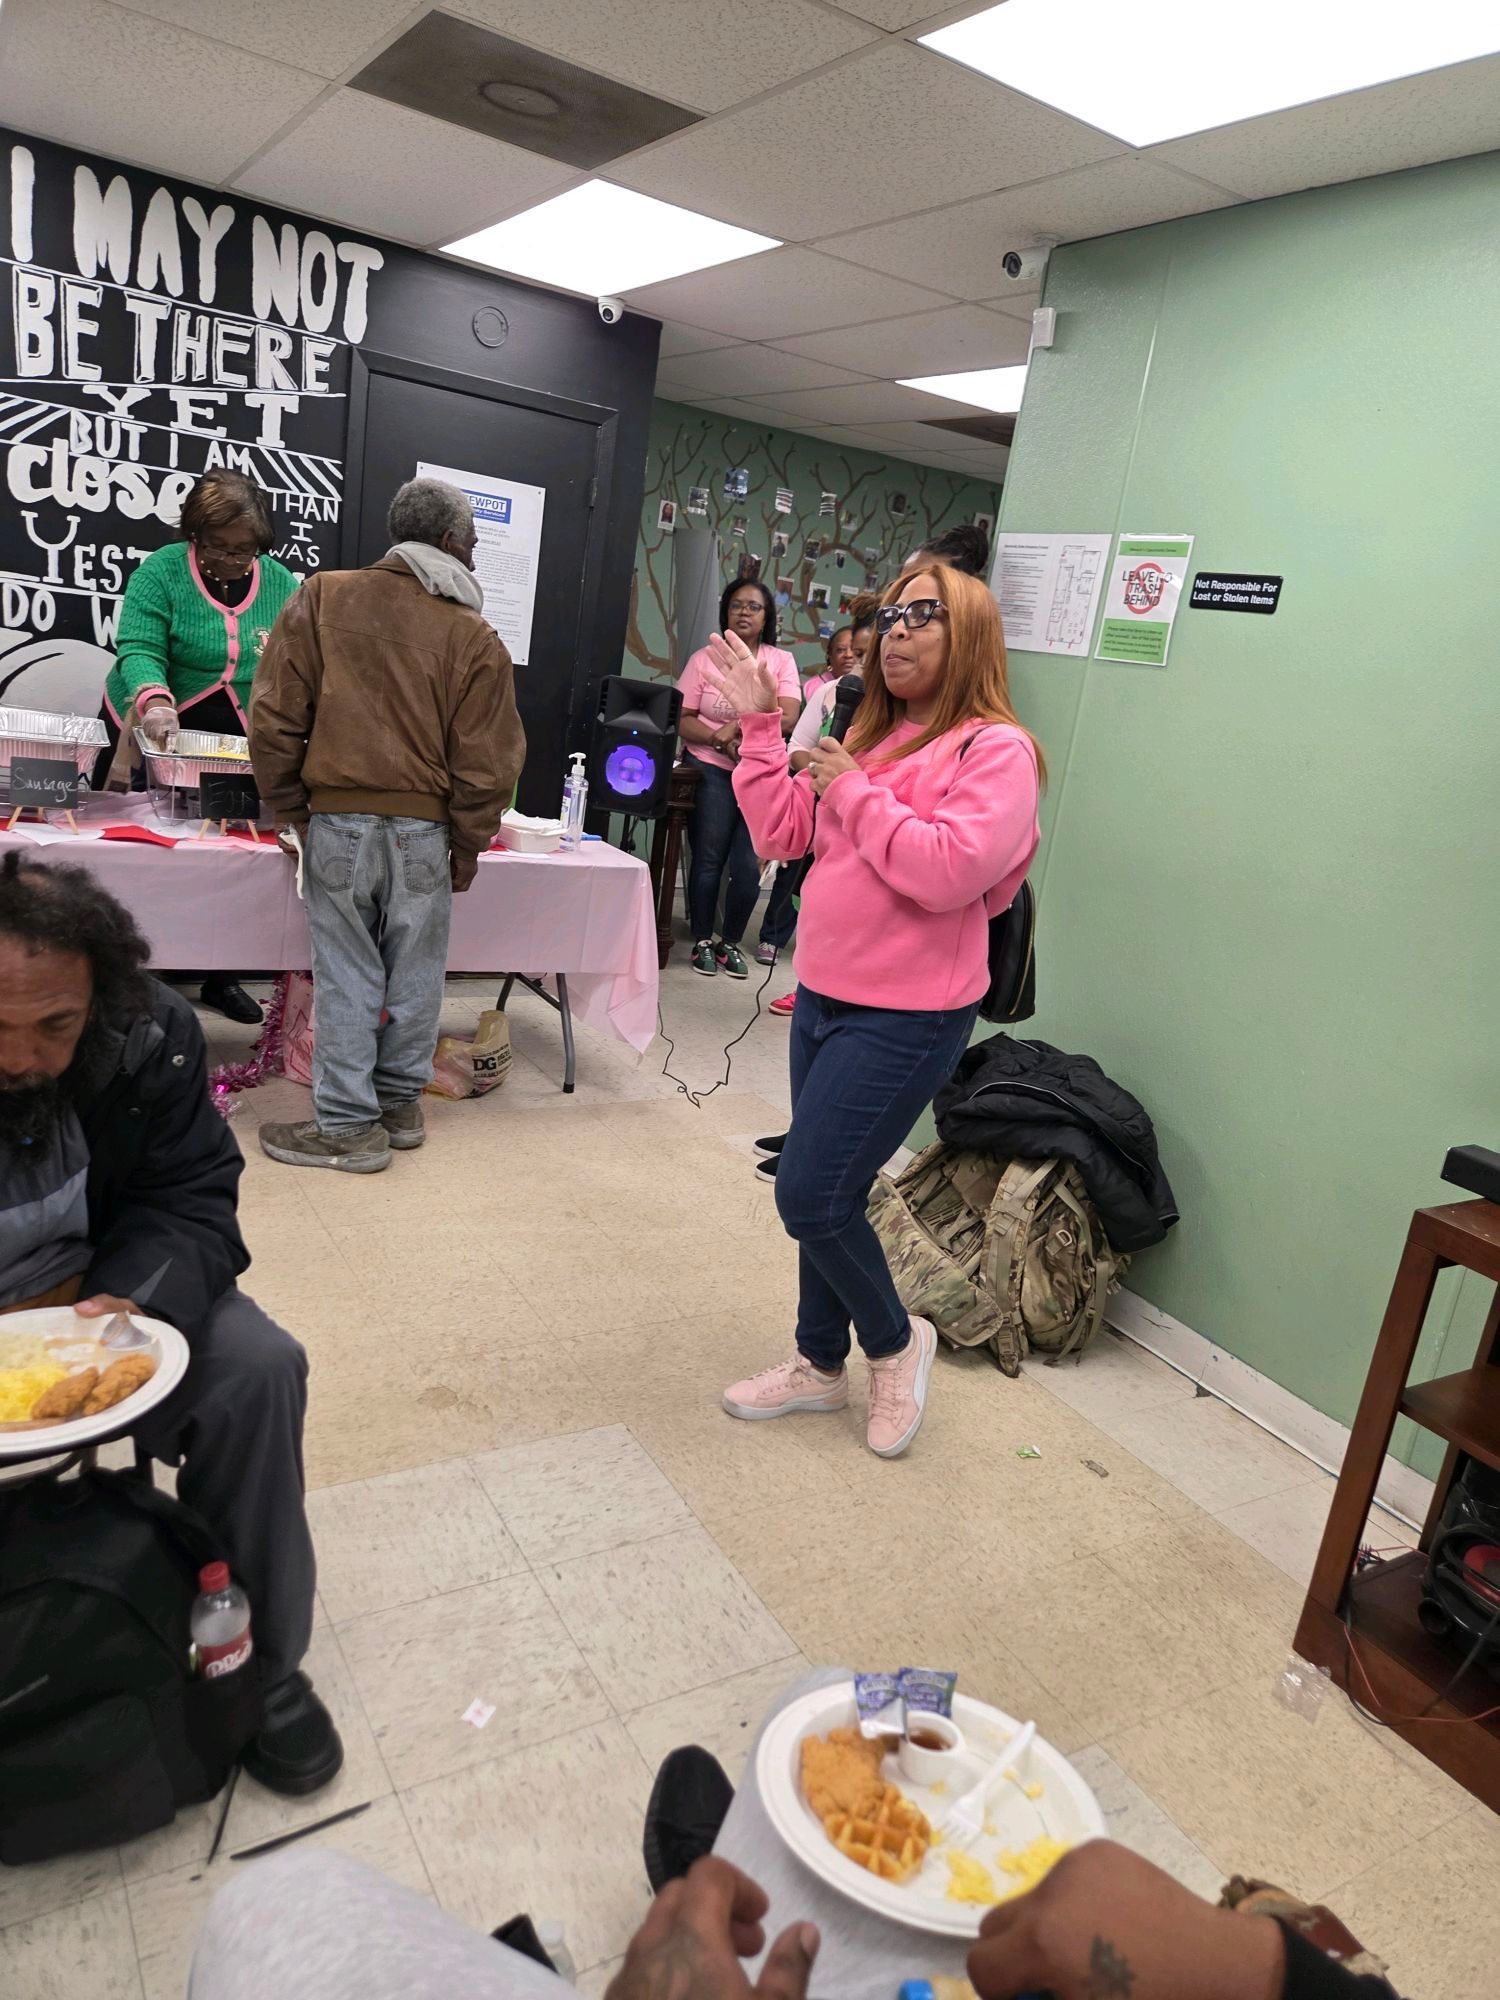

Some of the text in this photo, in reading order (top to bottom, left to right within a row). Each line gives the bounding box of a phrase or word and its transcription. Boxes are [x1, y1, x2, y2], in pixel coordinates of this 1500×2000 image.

[11, 145, 384, 344] I MAY NOT
[12, 265, 337, 392] BE THERE
[82, 385, 300, 448] YET
[69, 410, 250, 476] BUT I AM
[268, 490, 340, 524] THAN
[469, 495, 506, 511] EWPOT
[290, 521, 314, 542] I
[268, 543, 321, 568] WAS
[1122, 570, 1156, 584] LEAVE
[1128, 582, 1162, 595] TRASH
[1195, 579, 1279, 593] Not Responsible For
[2, 582, 57, 632] DO
[1123, 594, 1161, 607] BEHIND
[1192, 591, 1275, 605] Lost or Stolen Items
[13, 767, 79, 803] Sausage
[472, 1057, 497, 1071] DG
